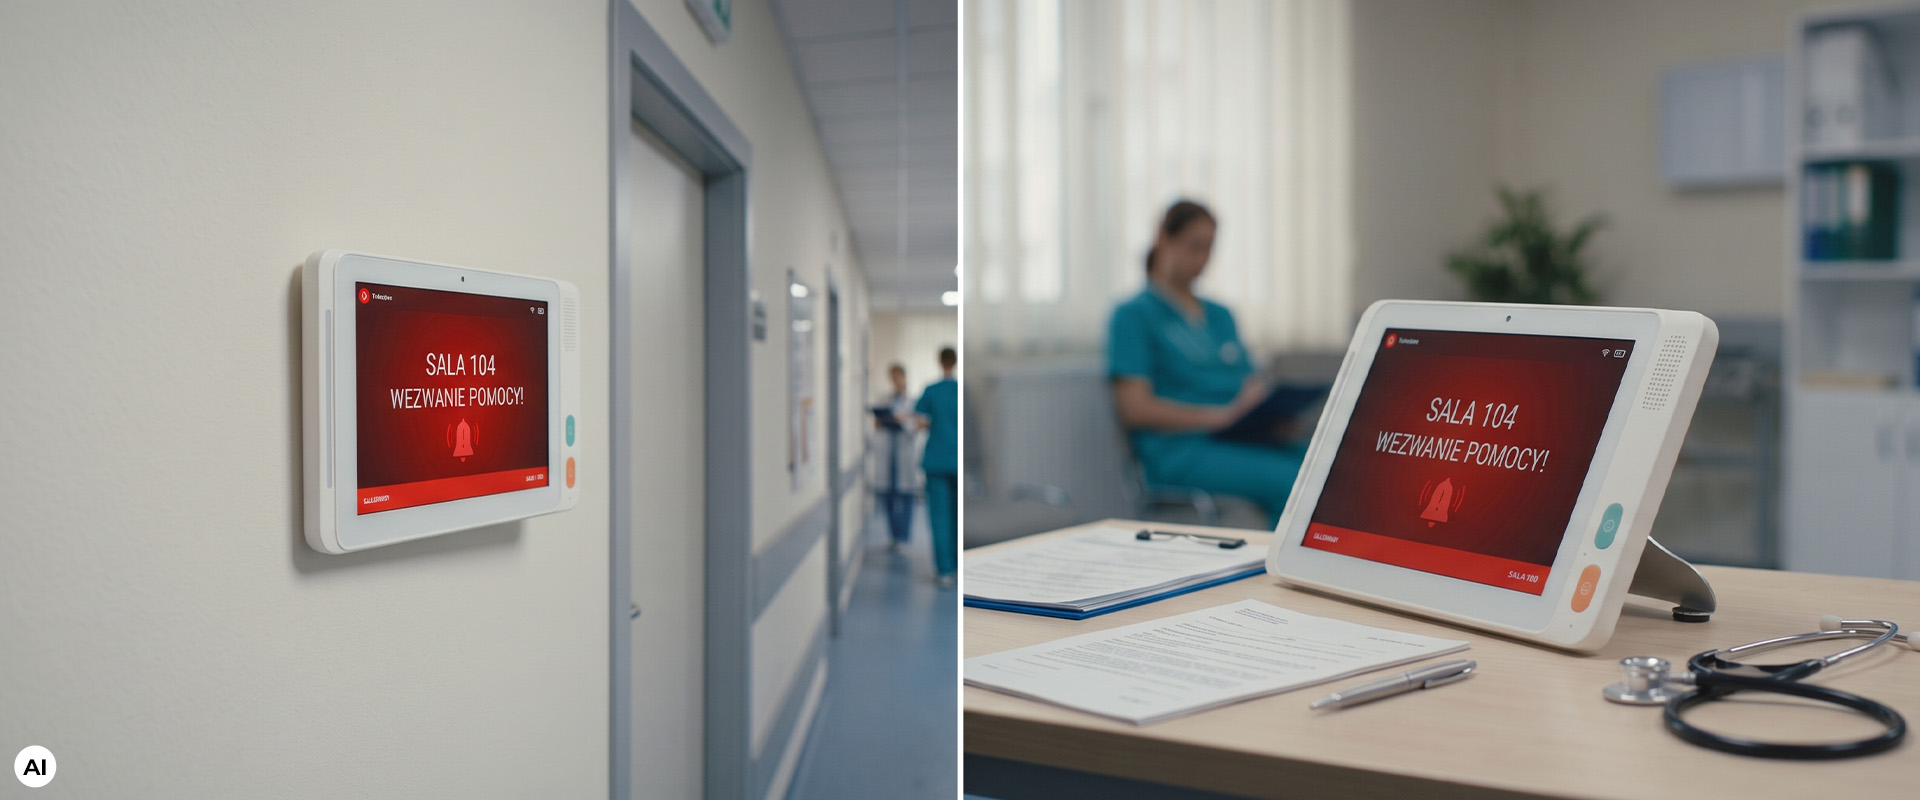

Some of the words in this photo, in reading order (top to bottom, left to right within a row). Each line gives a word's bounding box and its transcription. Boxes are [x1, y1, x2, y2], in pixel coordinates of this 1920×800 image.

[425, 352, 466, 376] SALA
[470, 353, 496, 376] 104
[390, 387, 466, 410] WEZWANIE
[469, 386, 524, 407] POMOCY!
[1426, 397, 1476, 426] SALA
[1482, 402, 1519, 430] 104
[1375, 430, 1465, 462] WEZWANIE
[1463, 441, 1550, 473] POMOCY!
[1507, 570, 1526, 581] SALA
